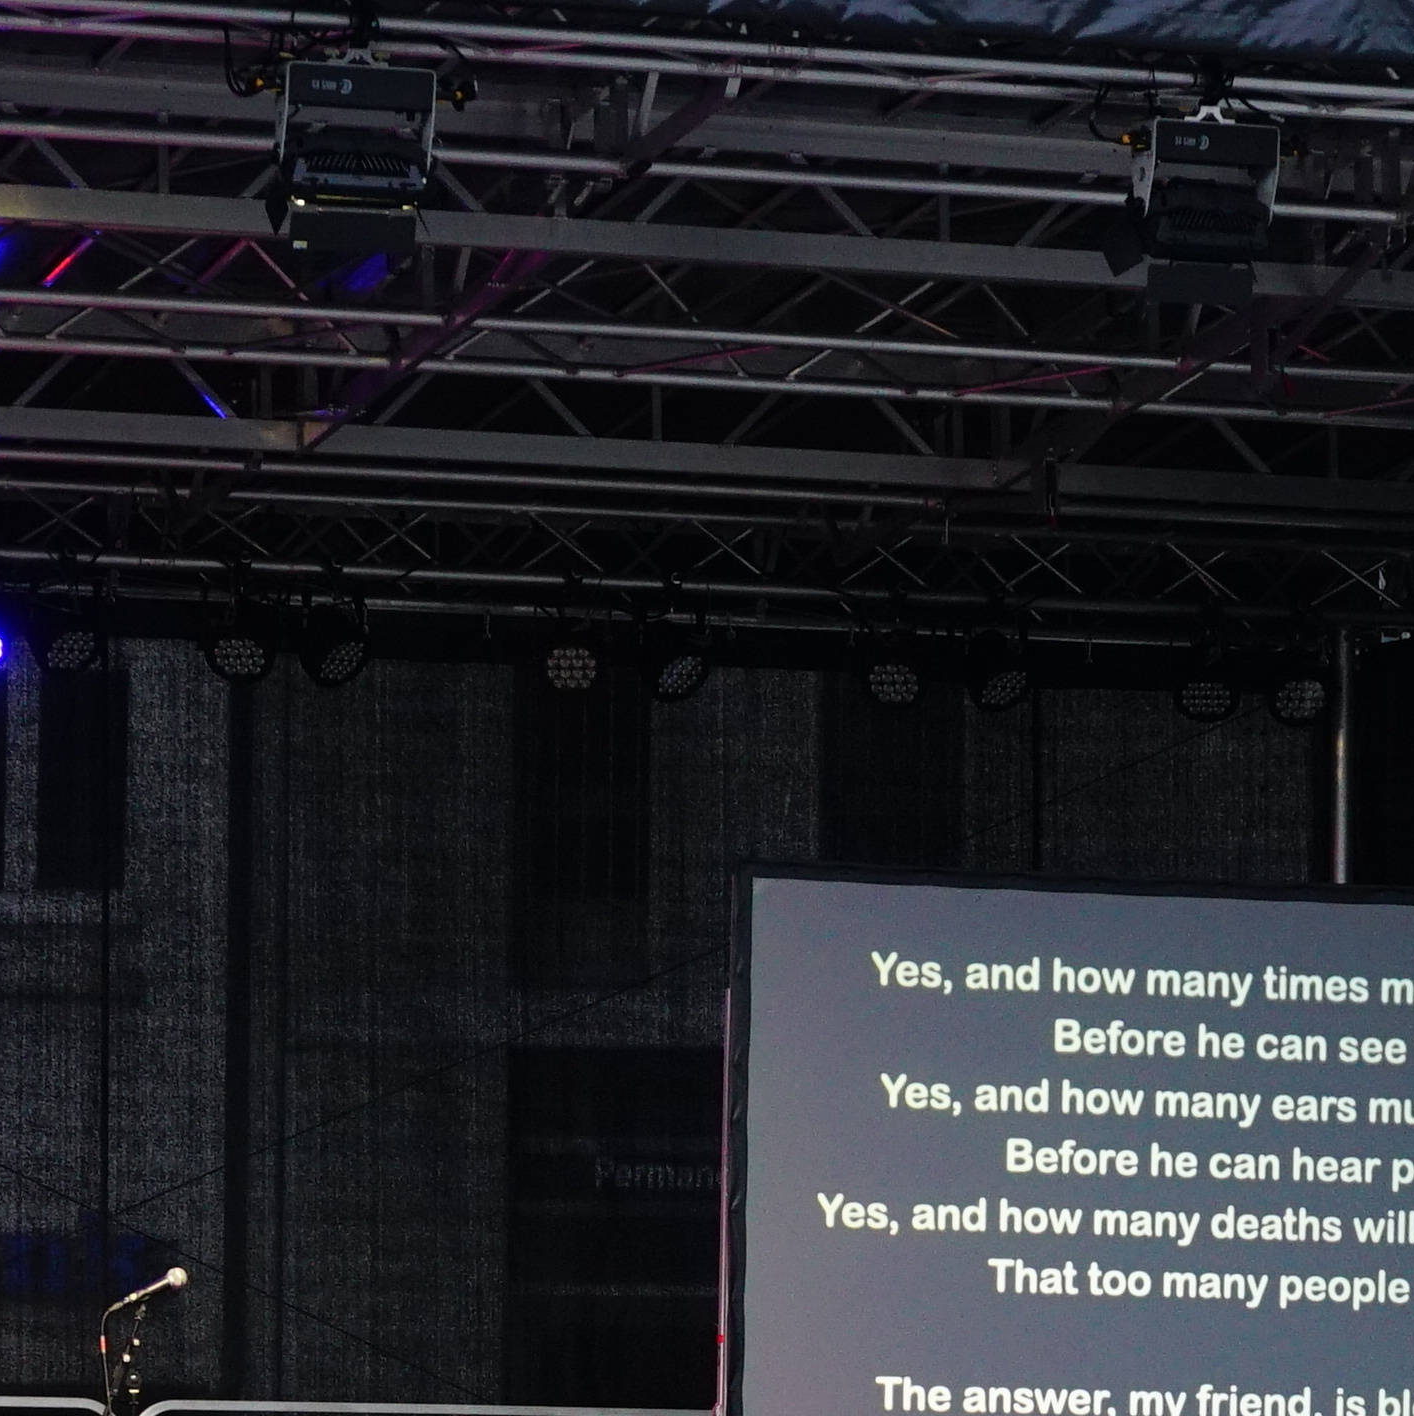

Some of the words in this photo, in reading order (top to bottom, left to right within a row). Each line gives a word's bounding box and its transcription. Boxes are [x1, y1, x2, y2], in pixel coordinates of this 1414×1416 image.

[870, 950, 953, 995] Yes,
[964, 956, 1041, 992] and
[1052, 956, 1136, 995] how
[1146, 968, 1254, 1008] many
[1262, 965, 1370, 1004] times
[1054, 1018, 1186, 1058] Before
[1197, 1022, 1246, 1060] he
[1256, 1033, 1328, 1062] can
[1338, 1036, 1407, 1065] see
[880, 1072, 962, 1117] Yes,
[974, 1077, 1050, 1113] and
[1061, 1078, 1145, 1117] how
[1154, 1090, 1262, 1129] many
[1271, 1094, 1358, 1123] ears
[1006, 1137, 1139, 1177] Before
[1150, 1141, 1198, 1179] he
[1208, 1152, 1280, 1181] can
[1292, 1146, 1382, 1184] hear
[816, 1192, 899, 1236] Yes,
[911, 1196, 987, 1232] and
[999, 1197, 1083, 1235] how
[1093, 1209, 1201, 1247] many
[1210, 1204, 1343, 1243] deaths
[987, 1257, 1080, 1296] That
[1086, 1261, 1152, 1298] too
[1162, 1271, 1269, 1309] many
[1279, 1269, 1411, 1311] people
[874, 1375, 952, 1413] The
